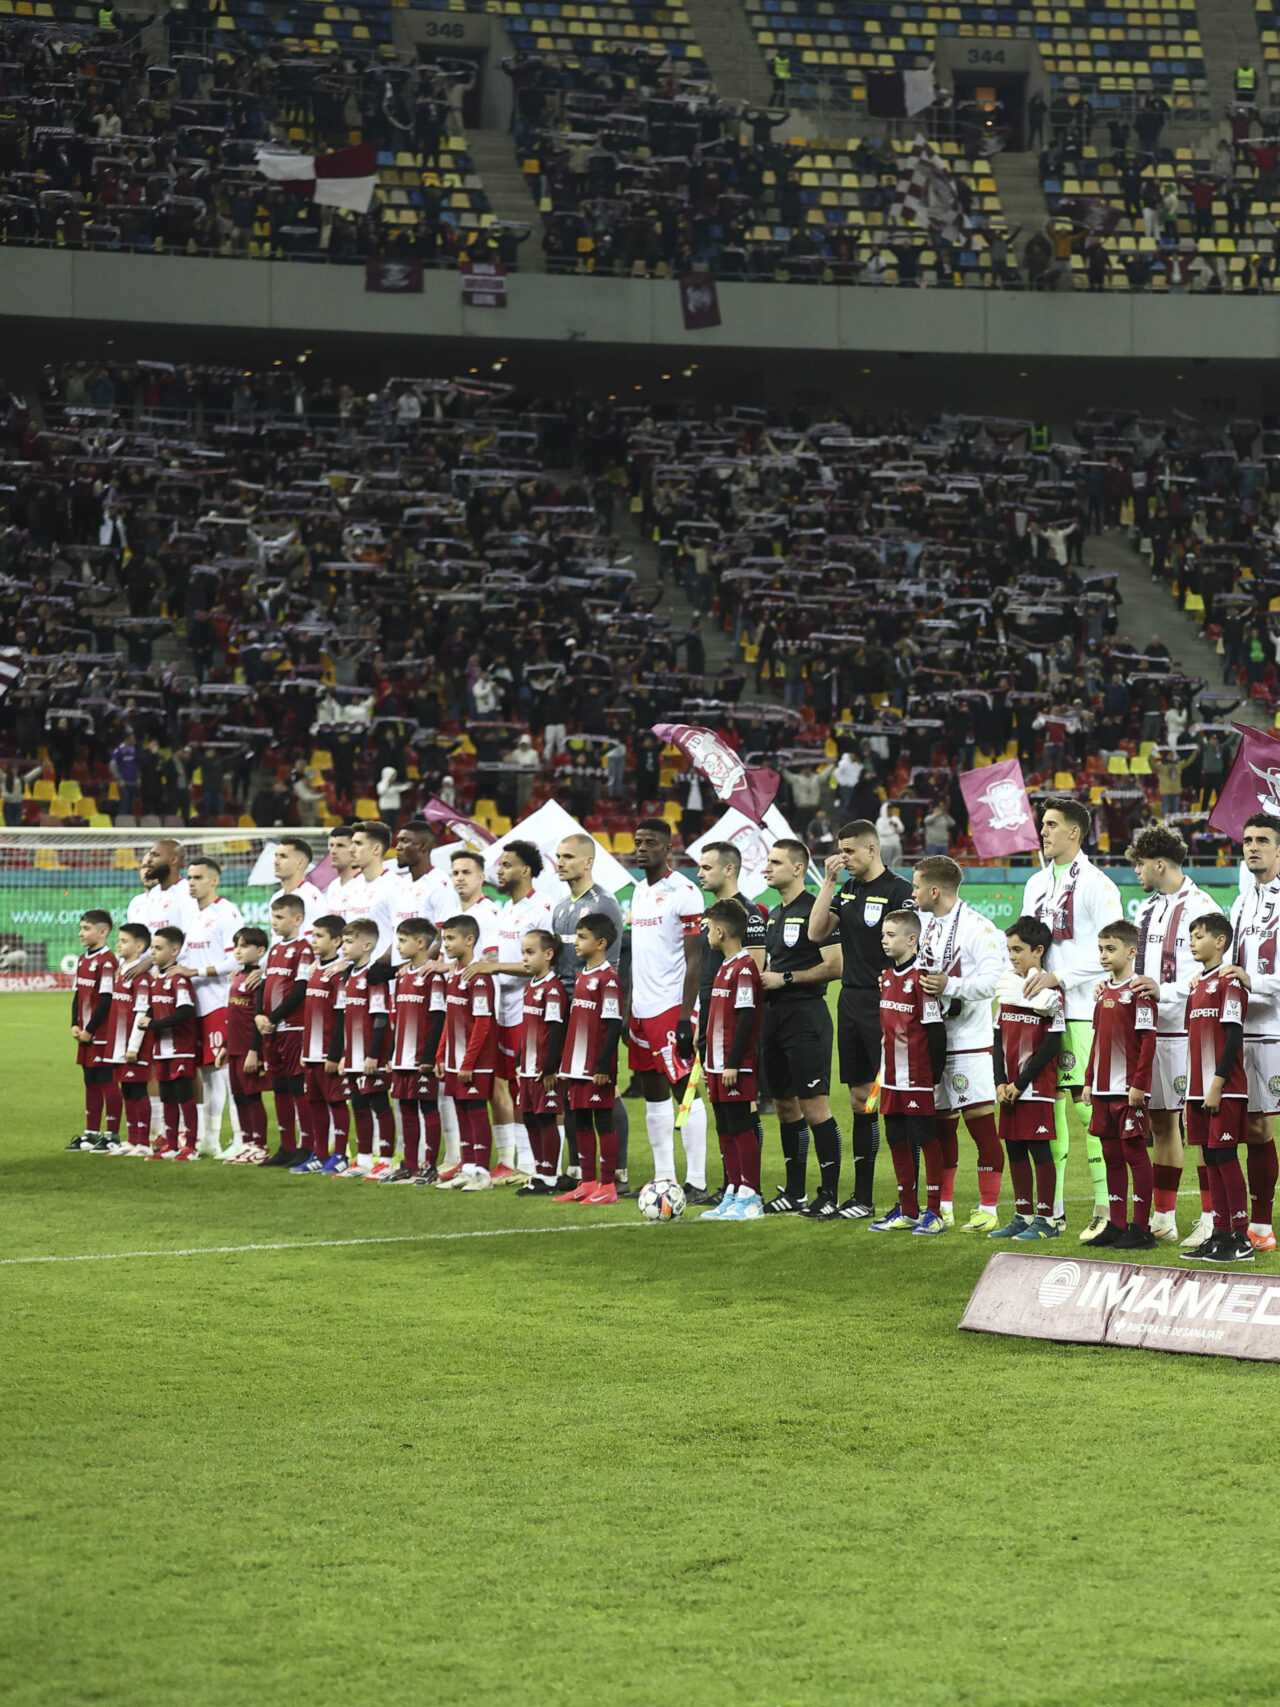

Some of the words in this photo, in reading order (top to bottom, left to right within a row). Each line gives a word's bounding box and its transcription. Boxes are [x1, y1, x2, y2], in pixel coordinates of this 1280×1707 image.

[425, 22, 464, 38] 346
[967, 49, 1006, 64] 344
[867, 904, 880, 912] FIFA
[208, 1031, 223, 1048] 10
[356, 1077, 367, 1090] 17
